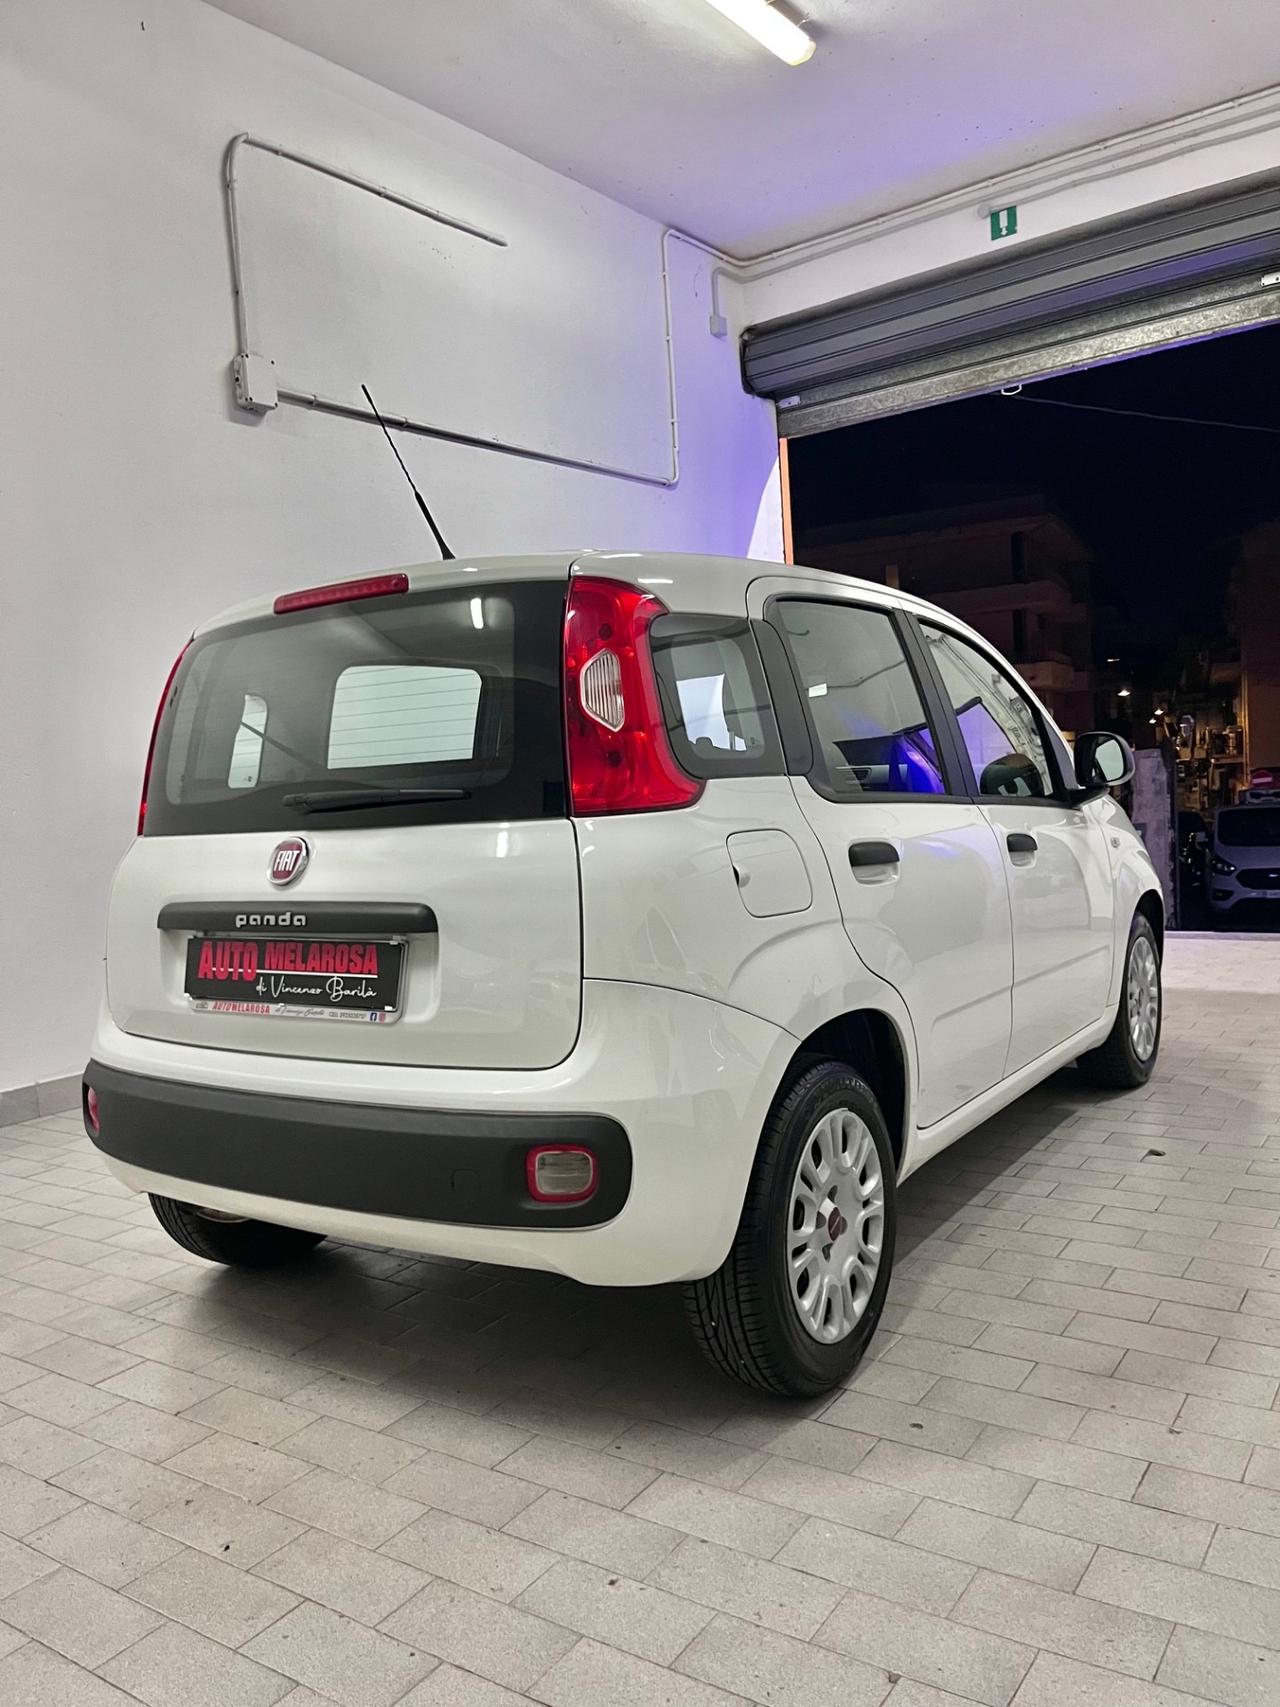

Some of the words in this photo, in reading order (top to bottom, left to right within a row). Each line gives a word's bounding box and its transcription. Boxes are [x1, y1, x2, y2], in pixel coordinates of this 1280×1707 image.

[273, 850, 300, 871] FIAT
[235, 912, 306, 928] panda
[197, 940, 259, 981] AUTO
[264, 941, 379, 975] MELAROSA
[255, 976, 267, 996] di
[270, 975, 323, 998] Vincenzo
[325, 976, 377, 1002] Barilà
